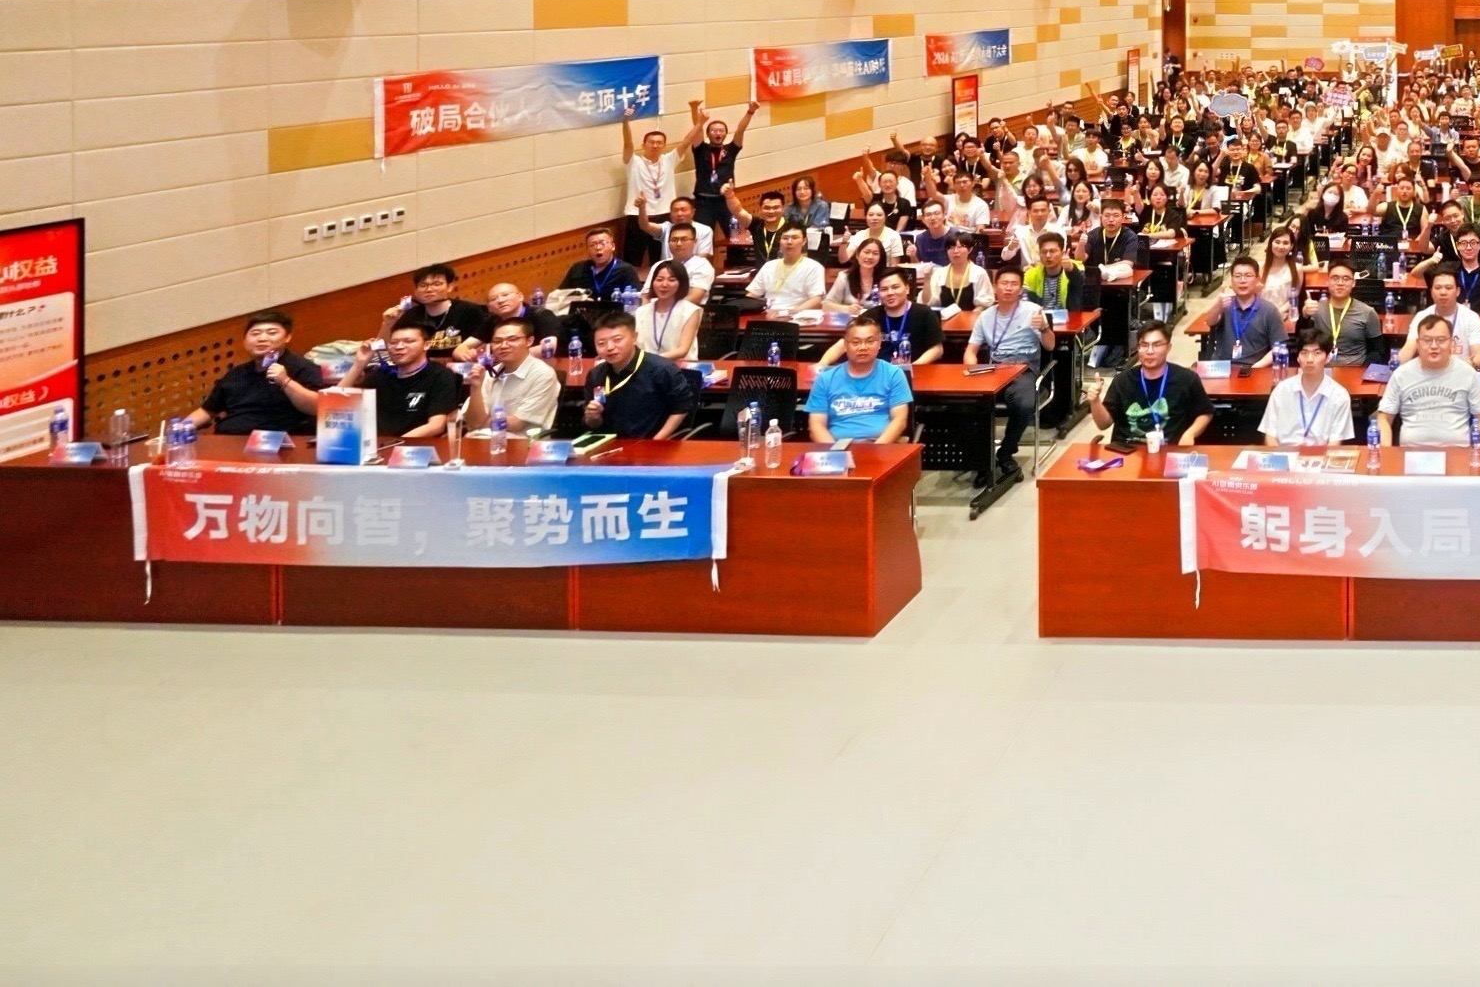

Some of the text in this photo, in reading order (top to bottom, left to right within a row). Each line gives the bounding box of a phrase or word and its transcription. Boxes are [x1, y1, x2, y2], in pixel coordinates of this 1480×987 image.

[1406, 385, 1458, 402] TSINGHUA
[183, 490, 689, 556] 万物向智，聚势而生
